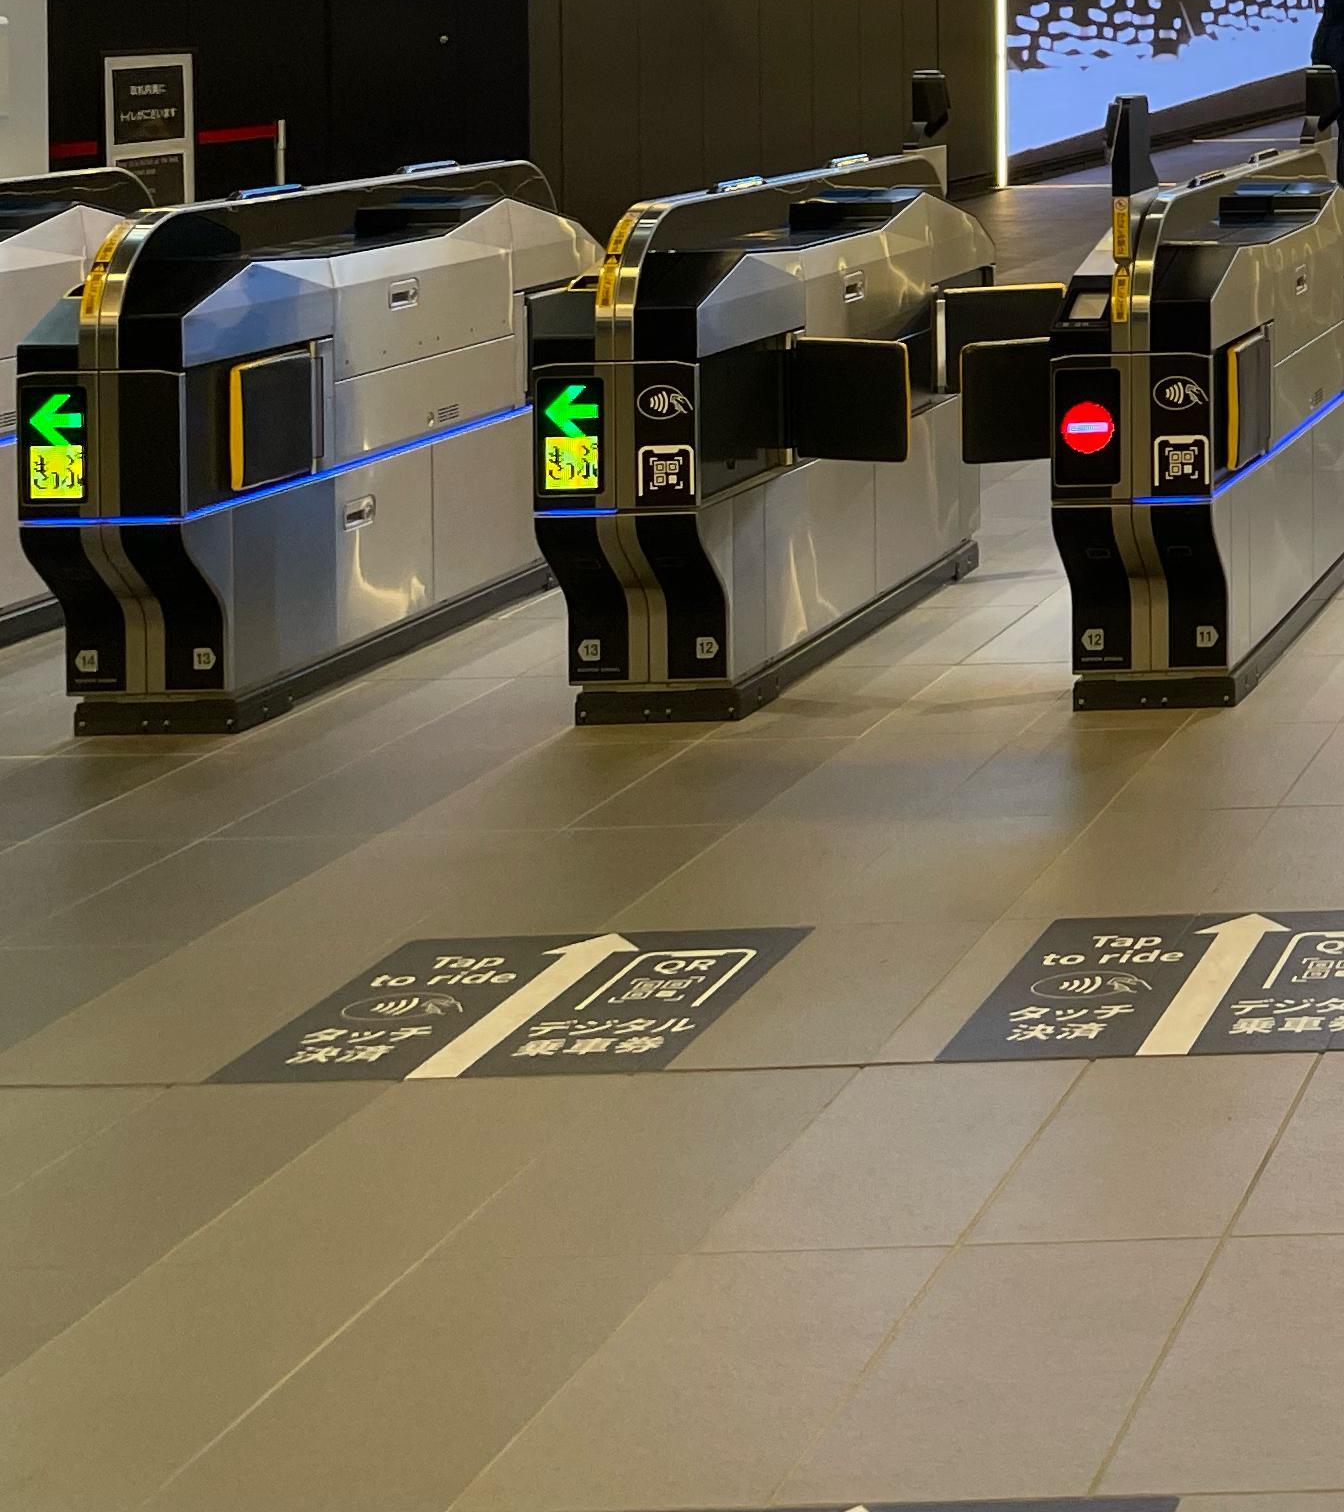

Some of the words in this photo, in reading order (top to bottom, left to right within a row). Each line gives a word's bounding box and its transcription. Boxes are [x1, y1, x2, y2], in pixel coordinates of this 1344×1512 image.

[1088, 634, 1102, 646] 12
[1199, 631, 1212, 642] 11
[583, 644, 598, 656] 13
[699, 642, 713, 654] 12
[81, 655, 96, 667] 14
[196, 653, 211, 665] 13
[1092, 934, 1163, 951] Tap
[432, 954, 505, 972] Tap
[652, 959, 717, 974] QR
[1041, 952, 1083, 967] to
[1098, 949, 1185, 965] ride
[370, 974, 412, 988] to
[427, 969, 518, 987] ride
[1007, 1004, 1136, 1022] タッチ
[300, 1024, 434, 1045] タッチ
[527, 1018, 697, 1035] デジタル
[1006, 1023, 1108, 1041] 決済
[286, 1045, 395, 1065] 決済
[512, 1036, 666, 1057] 乗車券
